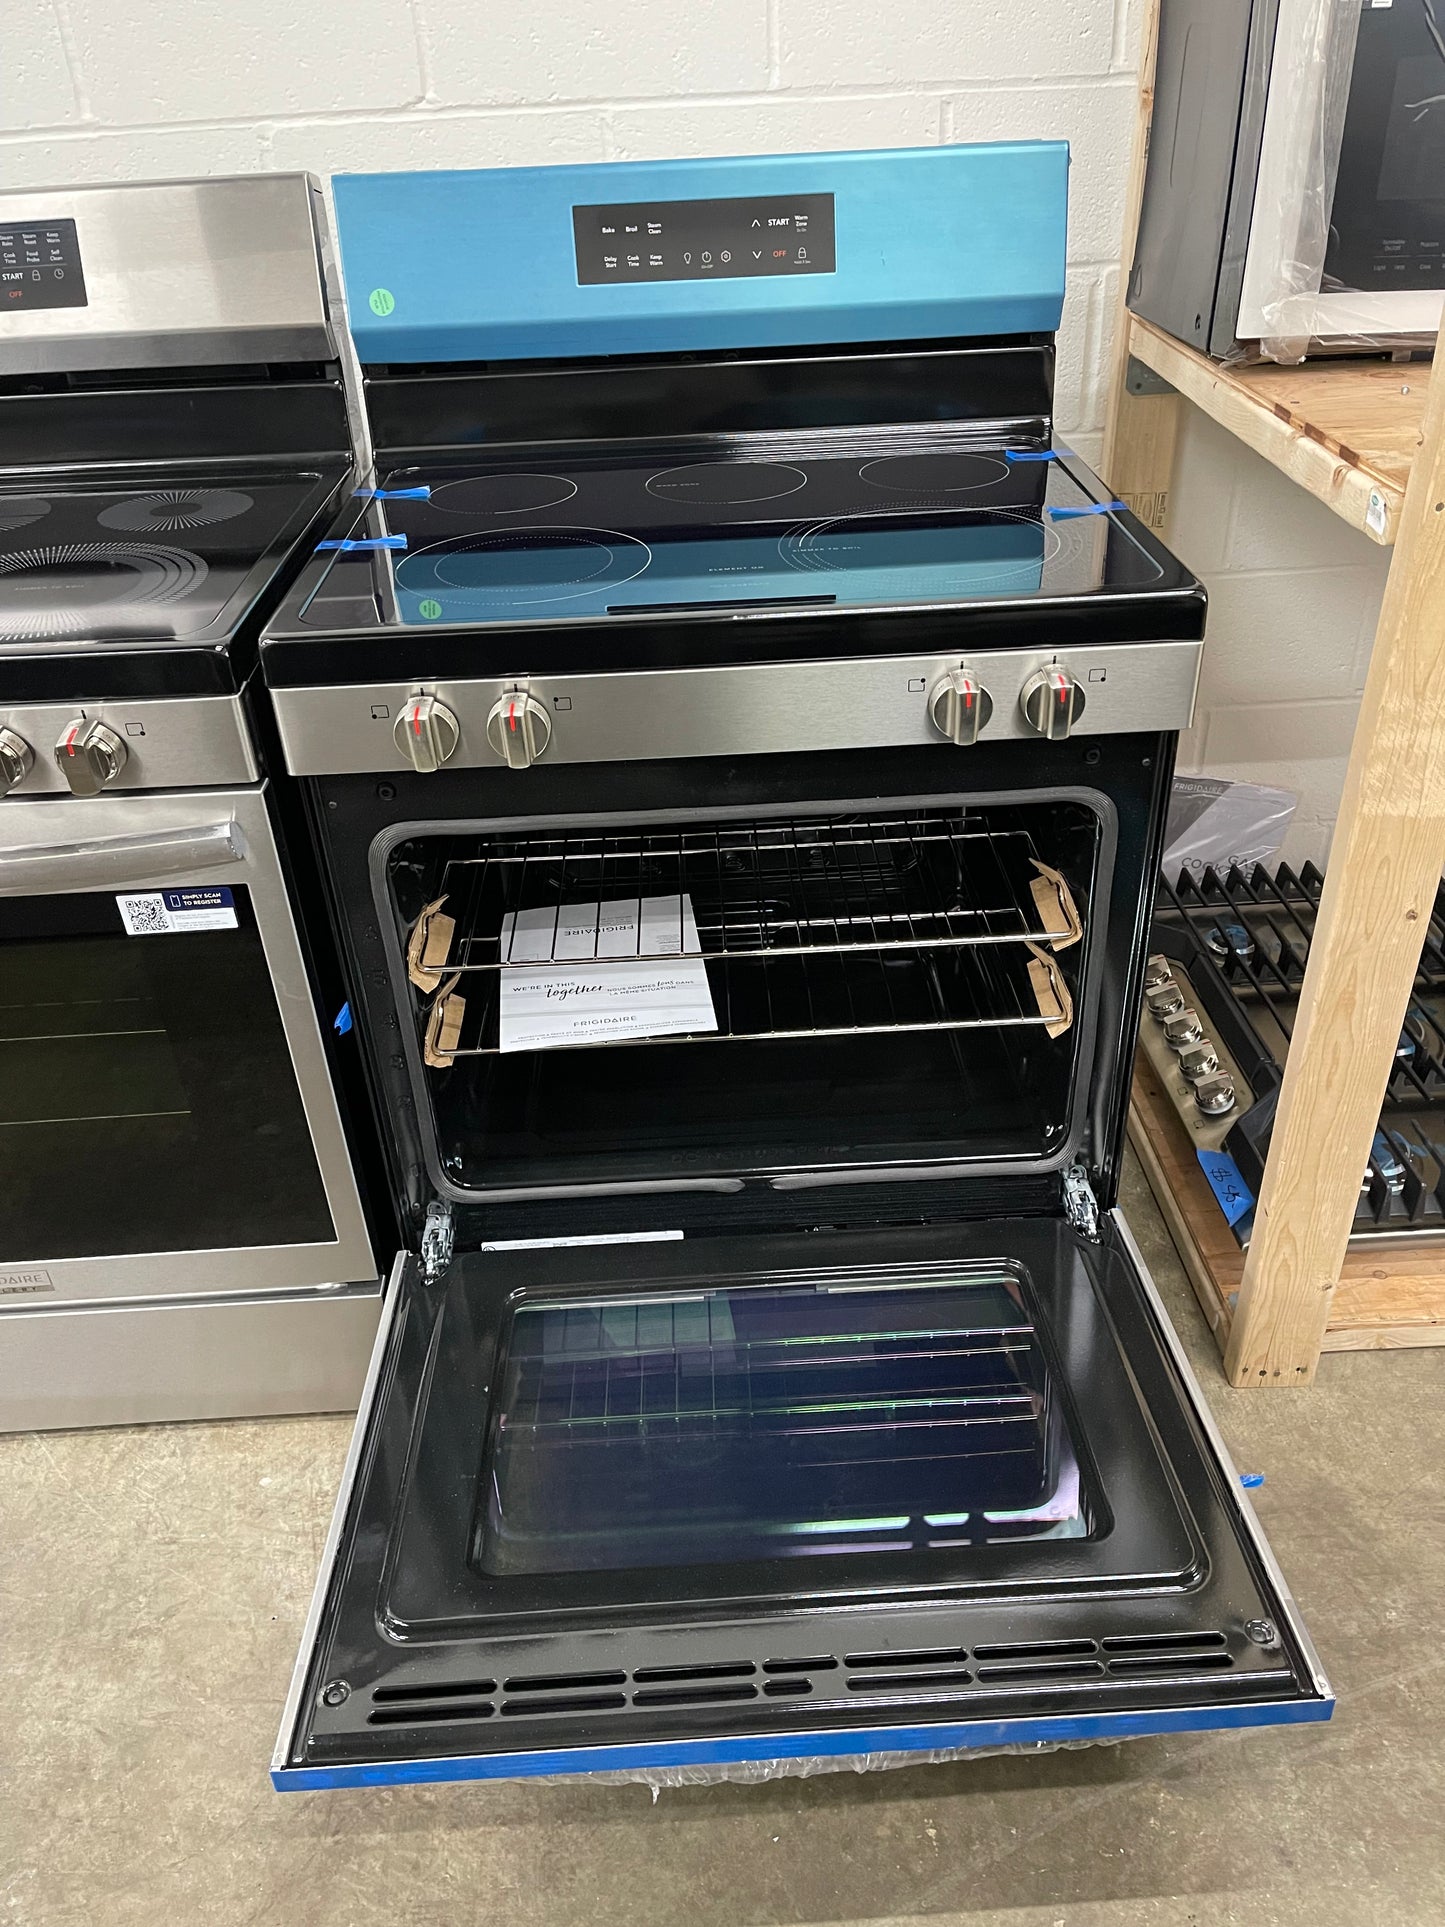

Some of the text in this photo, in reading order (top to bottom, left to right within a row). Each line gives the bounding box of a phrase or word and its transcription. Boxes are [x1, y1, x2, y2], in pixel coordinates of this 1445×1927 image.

[768, 218, 790, 226] START
[772, 250, 788, 258] OFF
[2, 272, 24, 281] START
[9, 290, 23, 298] OFF
[1173, 782, 1224, 794] FRIGIDAIRE
[564, 924, 634, 936] FRIGIDAIRE
[546, 985, 604, 1001] together
[640, 985, 677, 993] SITUATION
[573, 1015, 637, 1027] FRIGIDAIRE
[1209, 1167, 1233, 1183] $
